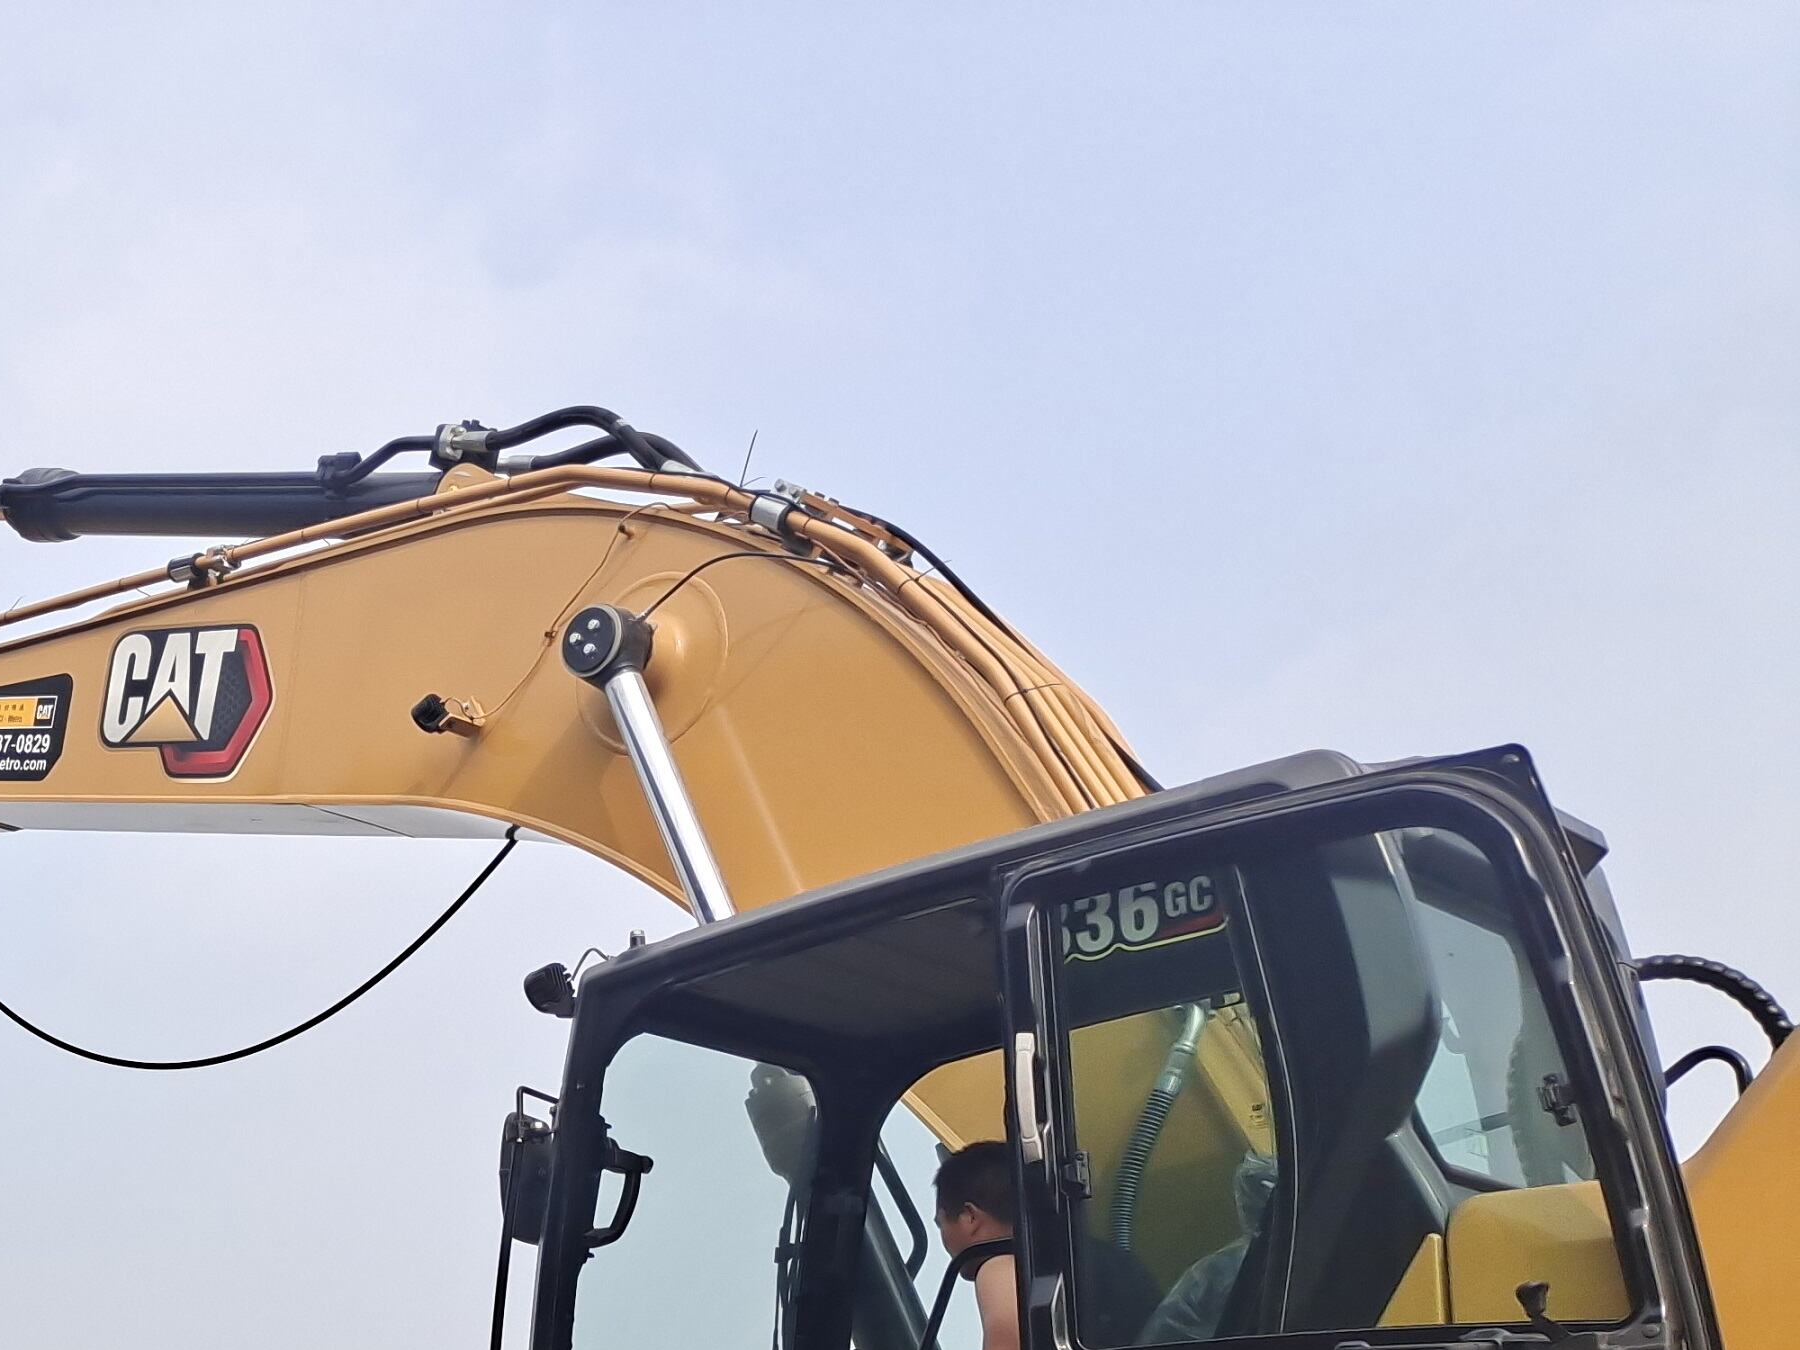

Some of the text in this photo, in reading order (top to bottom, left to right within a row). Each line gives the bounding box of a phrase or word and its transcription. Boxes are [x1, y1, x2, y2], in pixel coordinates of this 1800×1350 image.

[102, 629, 238, 743] CAT
[36, 704, 54, 719] CAT
[1163, 875, 1213, 918] GC
